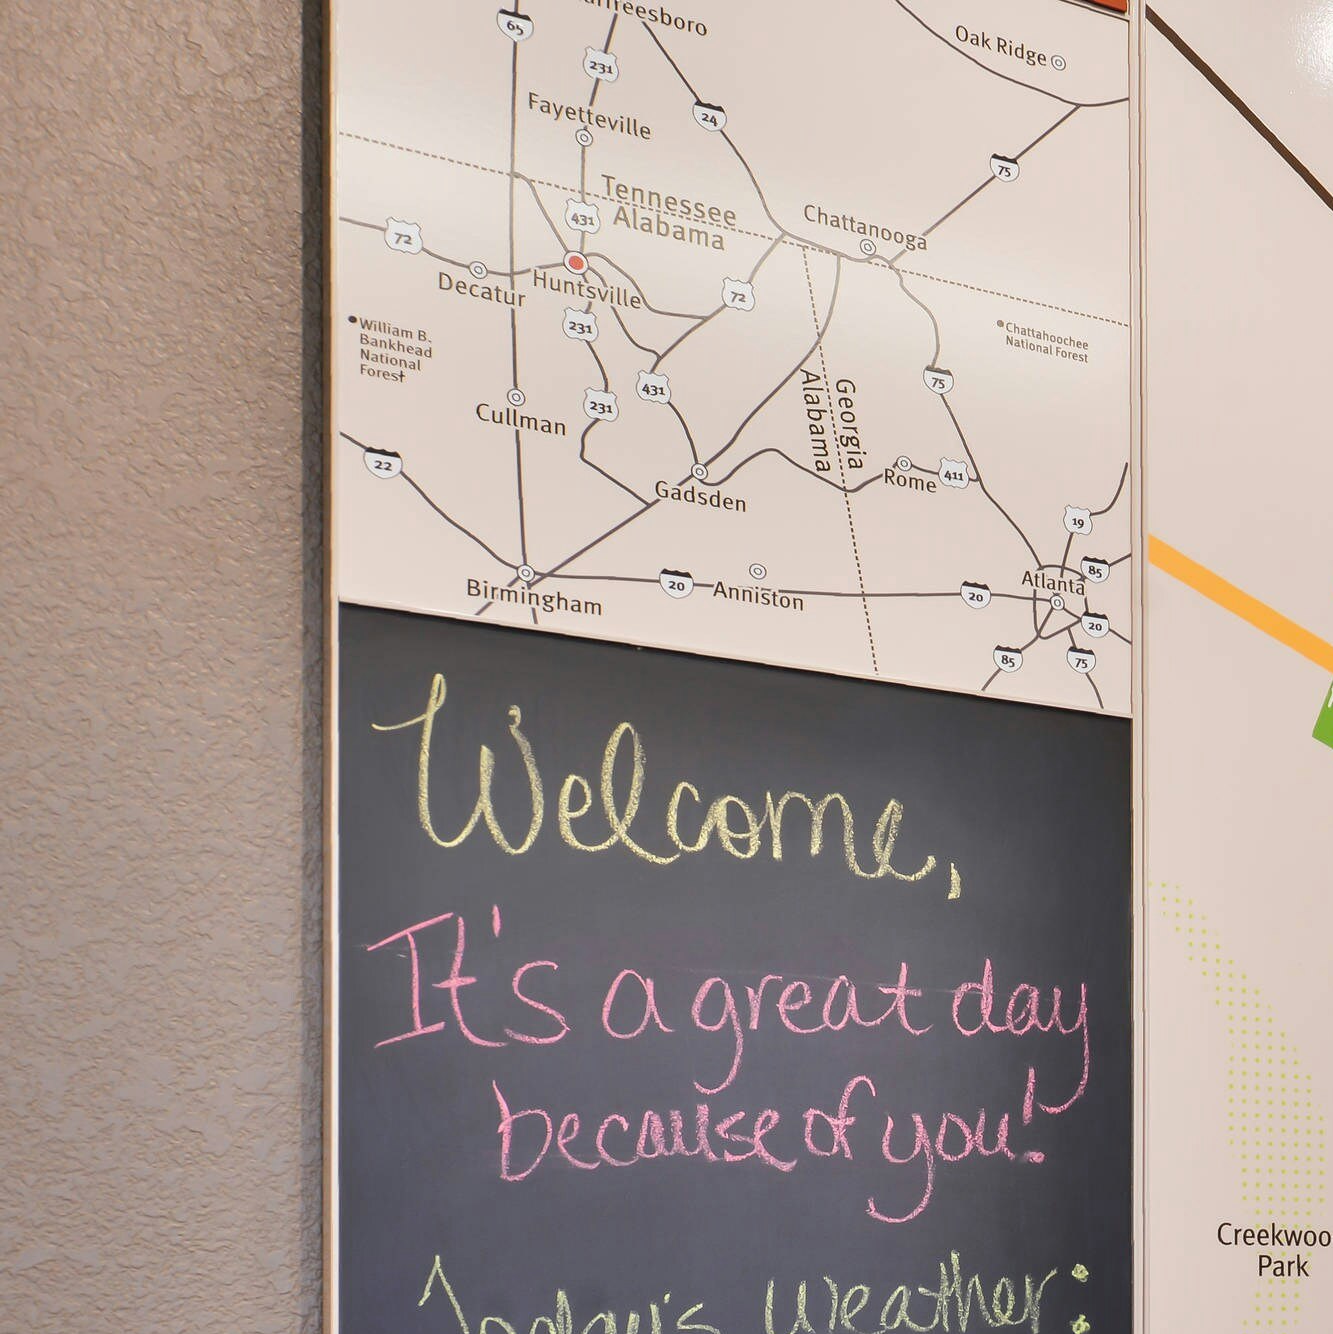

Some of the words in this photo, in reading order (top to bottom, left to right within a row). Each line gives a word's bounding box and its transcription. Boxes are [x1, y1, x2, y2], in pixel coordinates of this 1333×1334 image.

[506, 20, 525, 36] 65
[582, 0, 707, 36] reesboro
[955, 25, 993, 51] Oak
[996, 36, 1048, 68] Ridge
[589, 59, 613, 76] 231
[528, 91, 652, 141] Fayetteville
[701, 112, 718, 127] 24
[997, 165, 1012, 178] 75
[601, 174, 737, 227] Tennessee
[571, 211, 594, 227] 431
[613, 206, 725, 251] Alabama
[803, 204, 928, 252] Chattanooga
[394, 232, 412, 246] 72
[438, 272, 526, 308] Decatur
[533, 270, 642, 309] Huntsville
[731, 291, 746, 303] 72
[359, 317, 413, 339] William
[418, 330, 432, 343] B.
[568, 319, 593, 335] 231
[1006, 322, 1089, 350] Chattahoochee
[360, 333, 432, 358] Bankhead
[1006, 335, 1053, 355] National
[1055, 346, 1088, 363] Forest
[360, 348, 421, 371] National
[360, 363, 406, 383] Forest
[931, 376, 946, 390] 75
[641, 382, 666, 397] 431
[476, 403, 566, 436] Cullman
[589, 400, 613, 415] 231
[800, 368, 831, 473] Alabama
[835, 378, 866, 470] Georgia
[374, 459, 393, 471] 22
[944, 467, 965, 482] 411
[884, 468, 937, 494] Rome
[654, 480, 746, 513] Gadsden
[1071, 517, 1085, 529] 19
[1021, 571, 1086, 596] Atlanta
[1088, 565, 1103, 578] 85
[466, 578, 603, 616] Birmingham
[667, 580, 686, 592] 20
[712, 581, 804, 612] Anniston
[968, 591, 984, 603] 20
[1088, 621, 1103, 632] 20
[1001, 654, 1016, 668] 85
[1075, 657, 1088, 669] 75
[366, 905, 571, 1048] It's
[602, 969, 676, 1040] a
[691, 962, 933, 1094] great
[952, 957, 1089, 1113] day
[493, 1080, 797, 1183] because
[805, 1075, 877, 1160] of
[868, 1066, 1045, 1223] you!
[1257, 1254, 1310, 1278] Park
